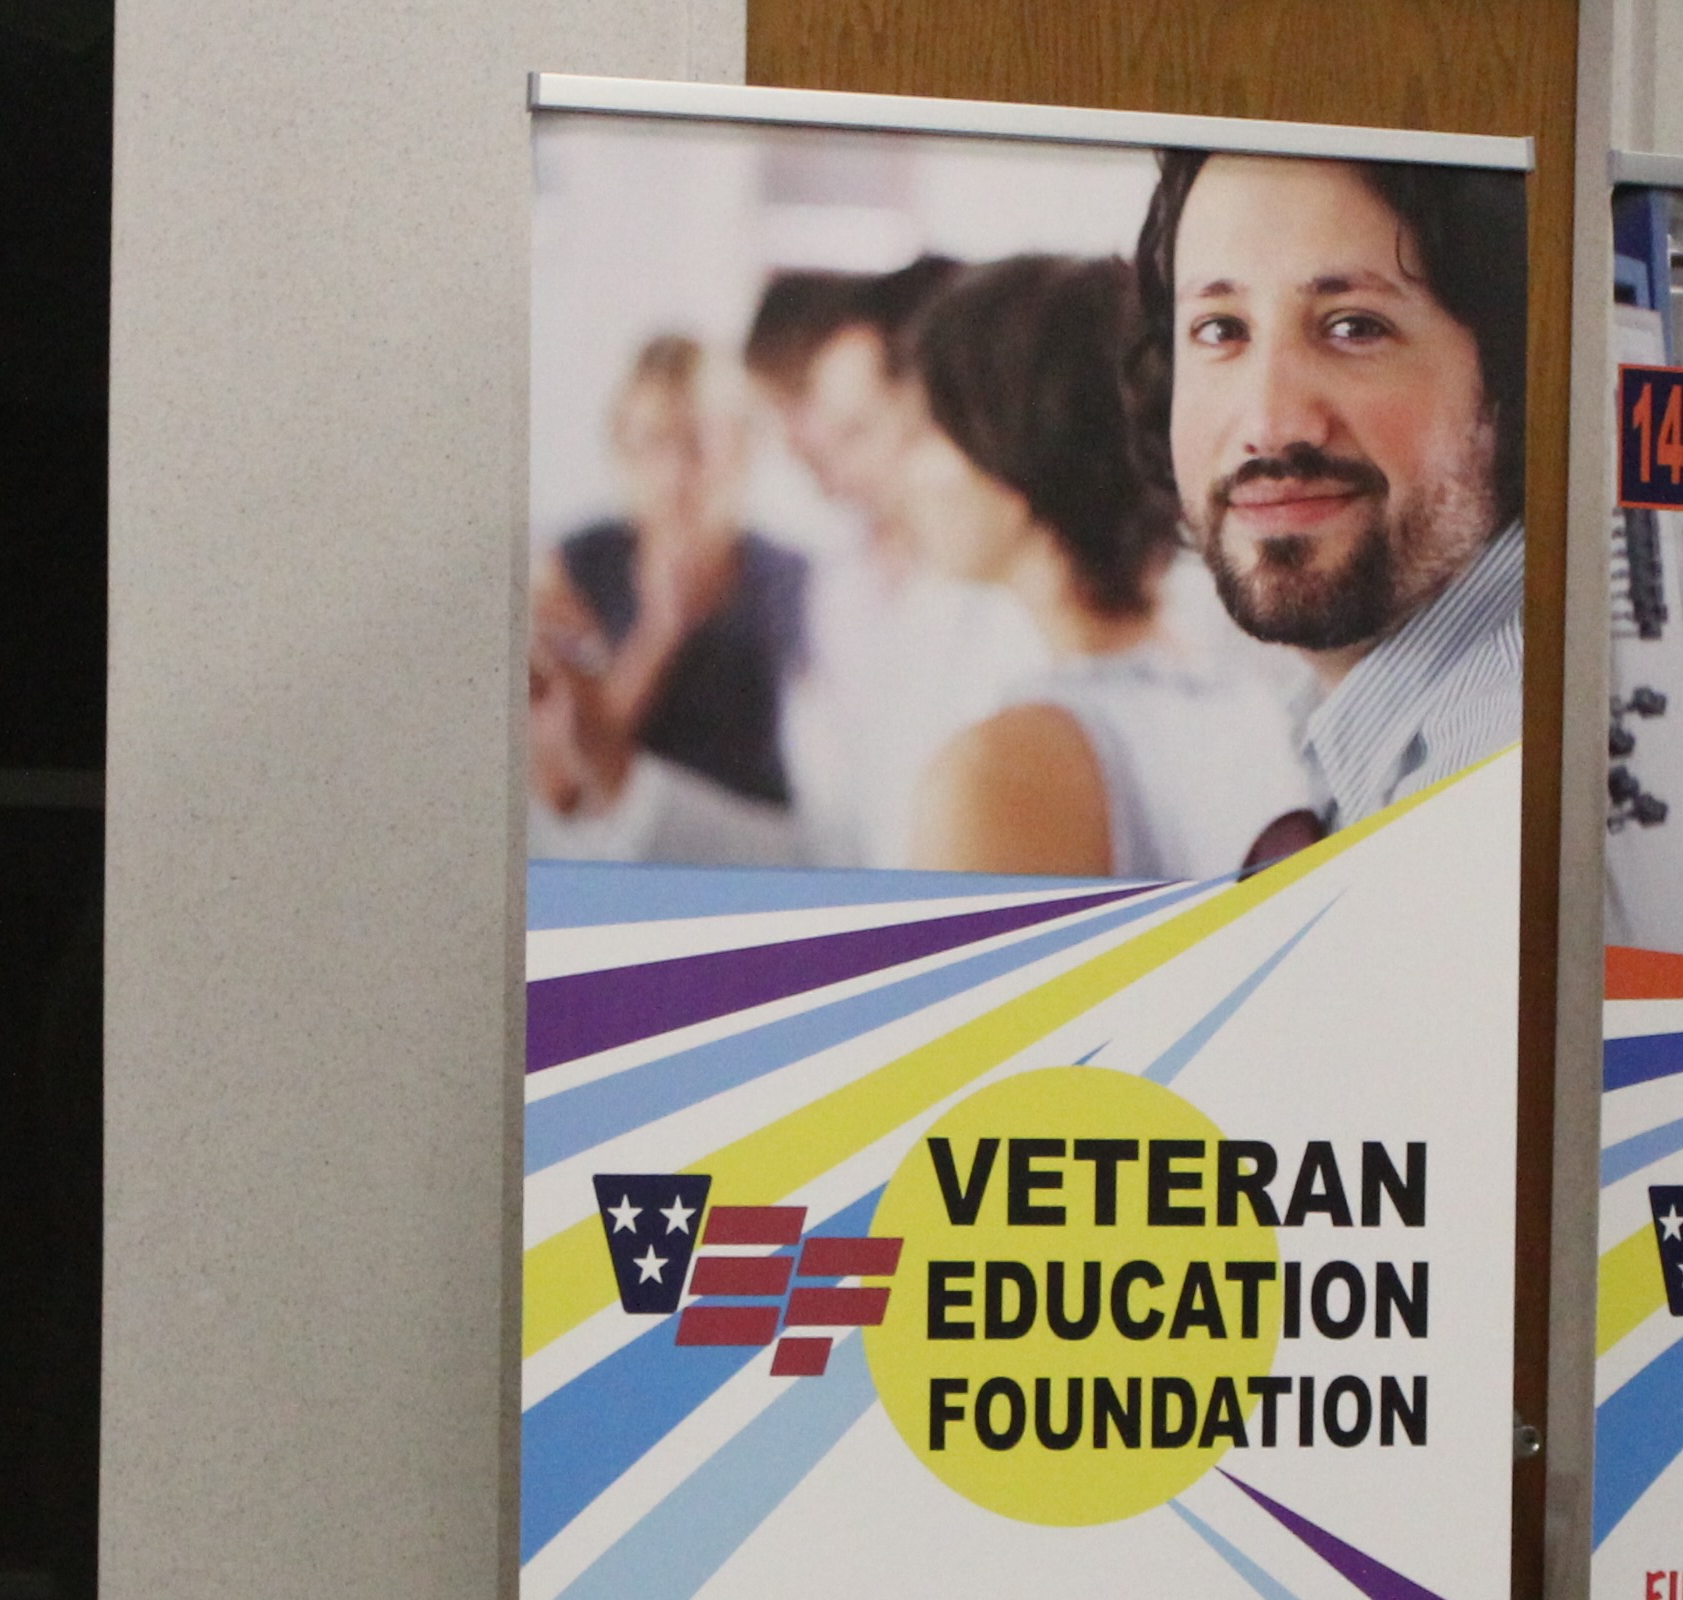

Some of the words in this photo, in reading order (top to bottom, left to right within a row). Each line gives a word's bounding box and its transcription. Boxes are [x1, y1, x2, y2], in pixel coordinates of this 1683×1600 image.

[926, 1137, 1427, 1228] VETERAN
[926, 1259, 1428, 1341] EDUCATION
[929, 1374, 1428, 1451] FOUNDATION
